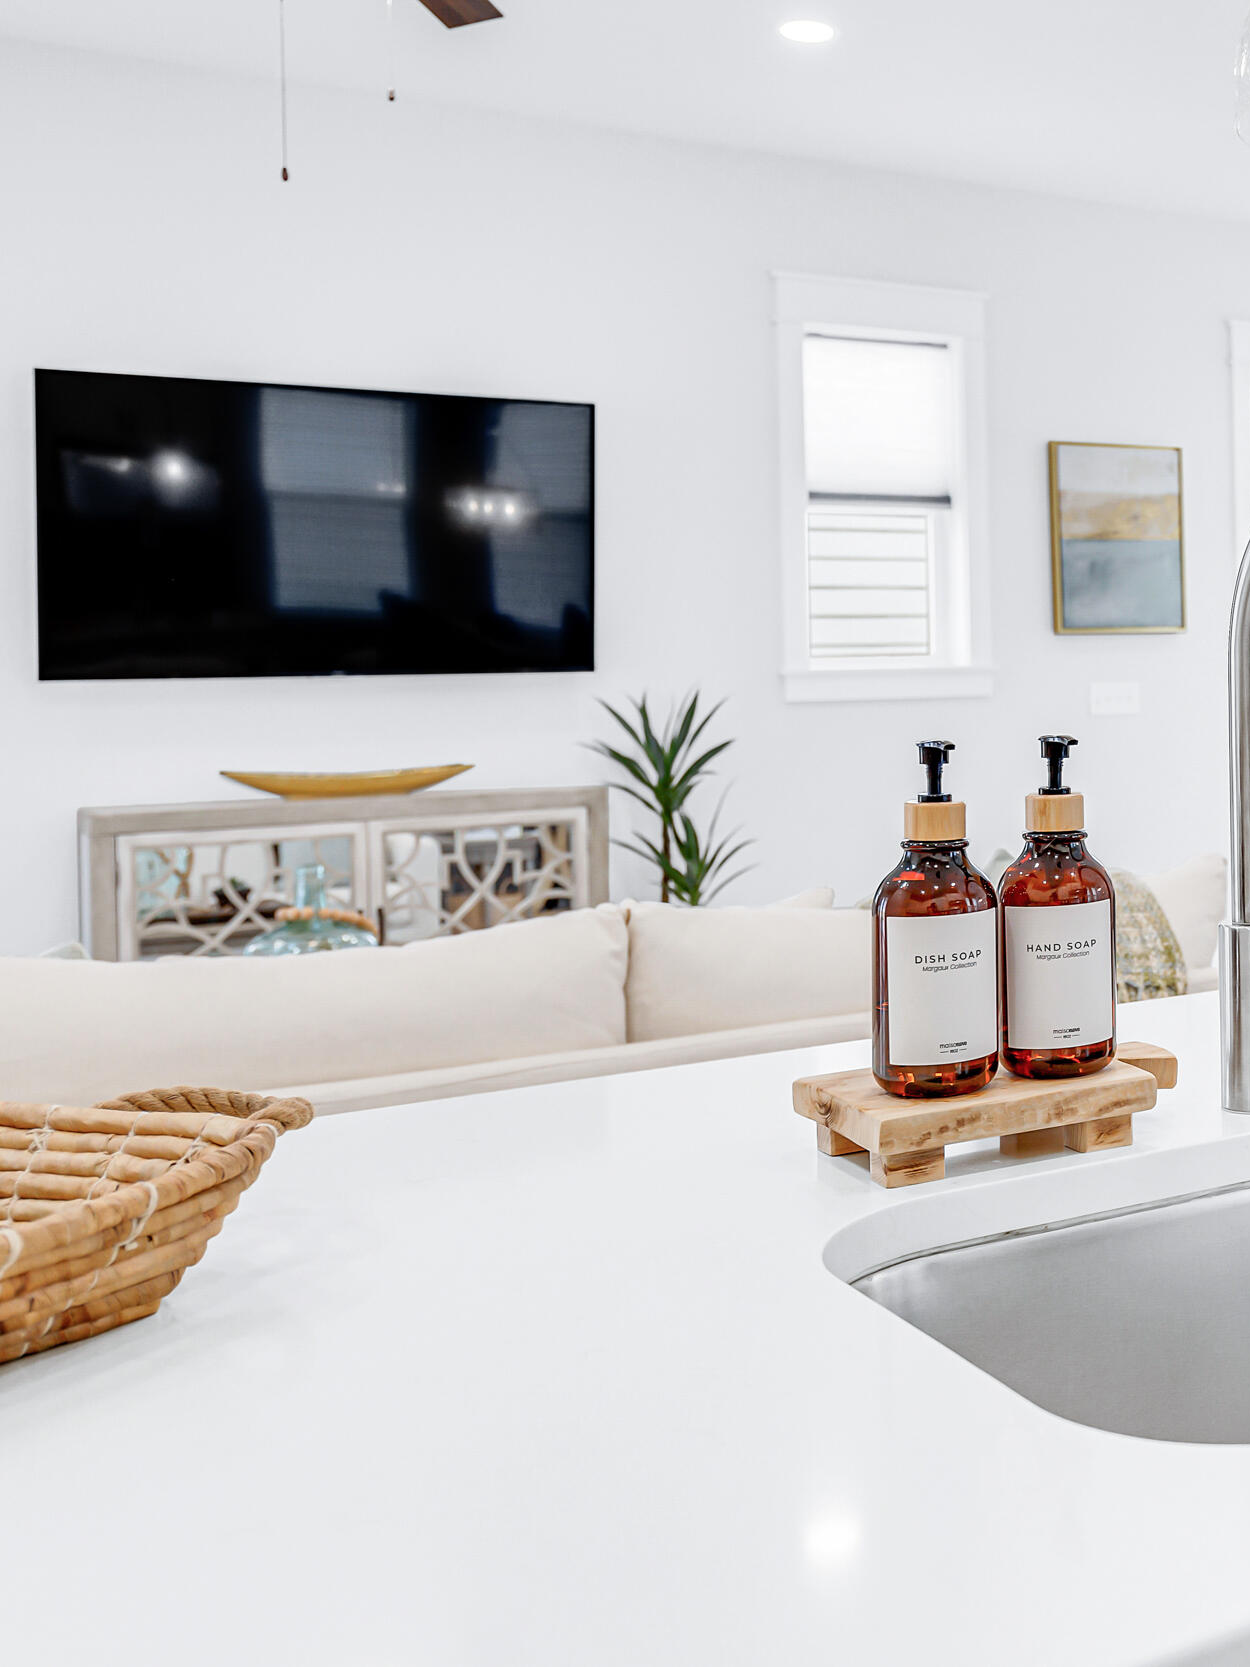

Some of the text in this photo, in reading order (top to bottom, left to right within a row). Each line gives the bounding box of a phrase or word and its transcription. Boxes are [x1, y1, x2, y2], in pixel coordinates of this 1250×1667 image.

[1026, 939, 1097, 952] HAND SOAP
[914, 949, 982, 964] DISH SOAP
[1036, 950, 1090, 961] Margaux Collection
[922, 961, 977, 973] Margaux Collection
